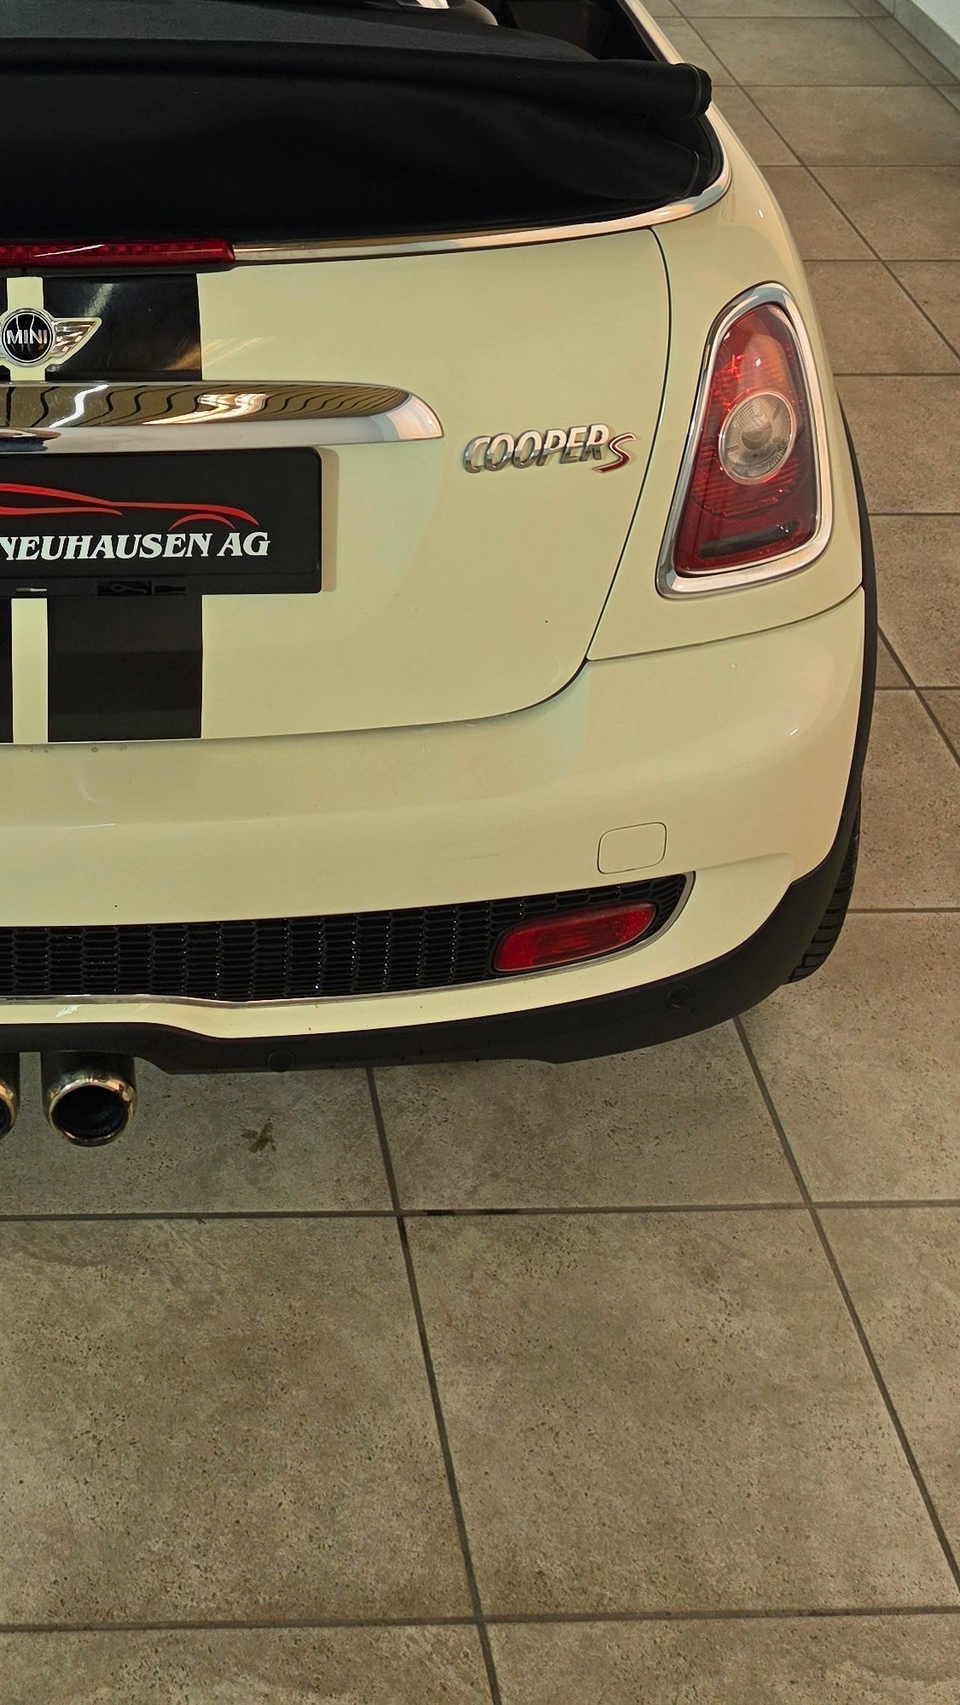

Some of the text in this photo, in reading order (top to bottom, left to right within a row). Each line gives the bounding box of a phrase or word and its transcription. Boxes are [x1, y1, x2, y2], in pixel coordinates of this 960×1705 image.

[6, 329, 48, 345] MINI
[463, 423, 637, 473] COOPER S
[216, 531, 271, 557] AG
